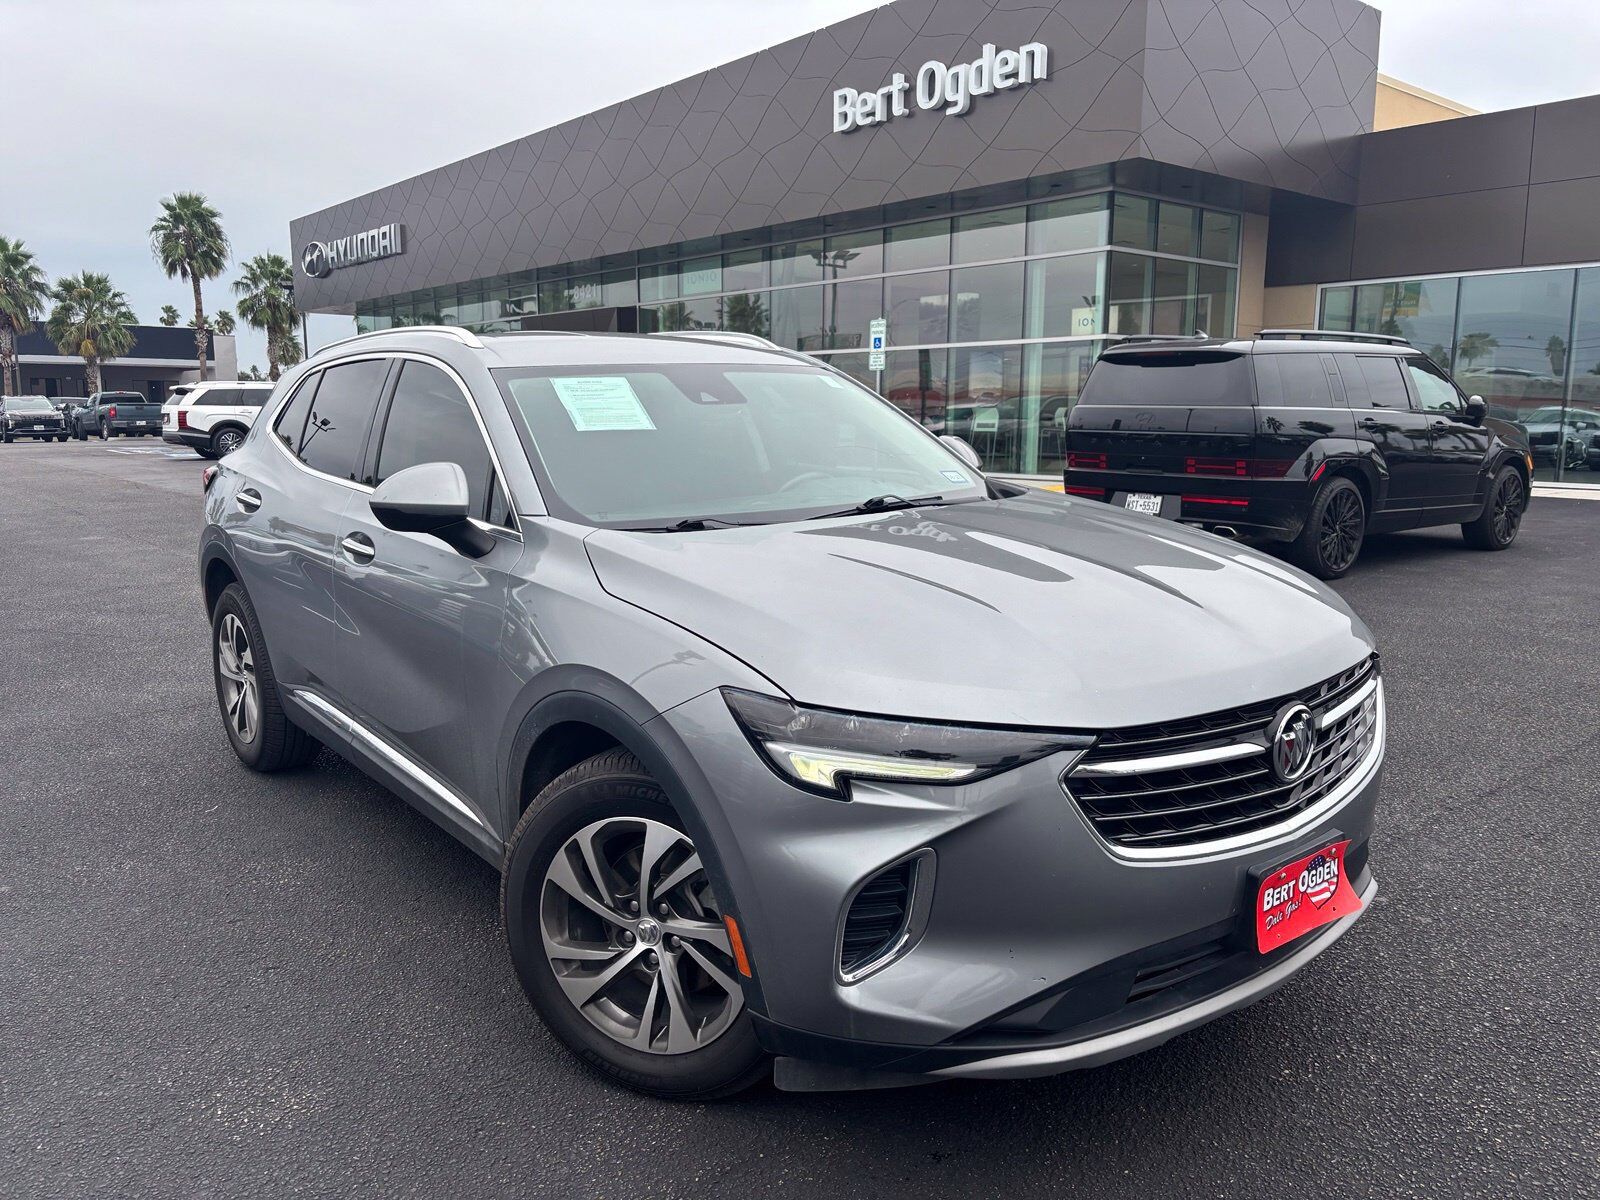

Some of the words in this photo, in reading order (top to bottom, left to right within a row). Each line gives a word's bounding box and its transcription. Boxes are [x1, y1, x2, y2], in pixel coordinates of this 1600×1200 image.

[833, 72, 909, 132] Bert
[916, 42, 1048, 115] Ogden
[327, 223, 401, 269] HYUNDAI
[1263, 880, 1296, 912] BERT
[1298, 858, 1338, 892] OGDEN
